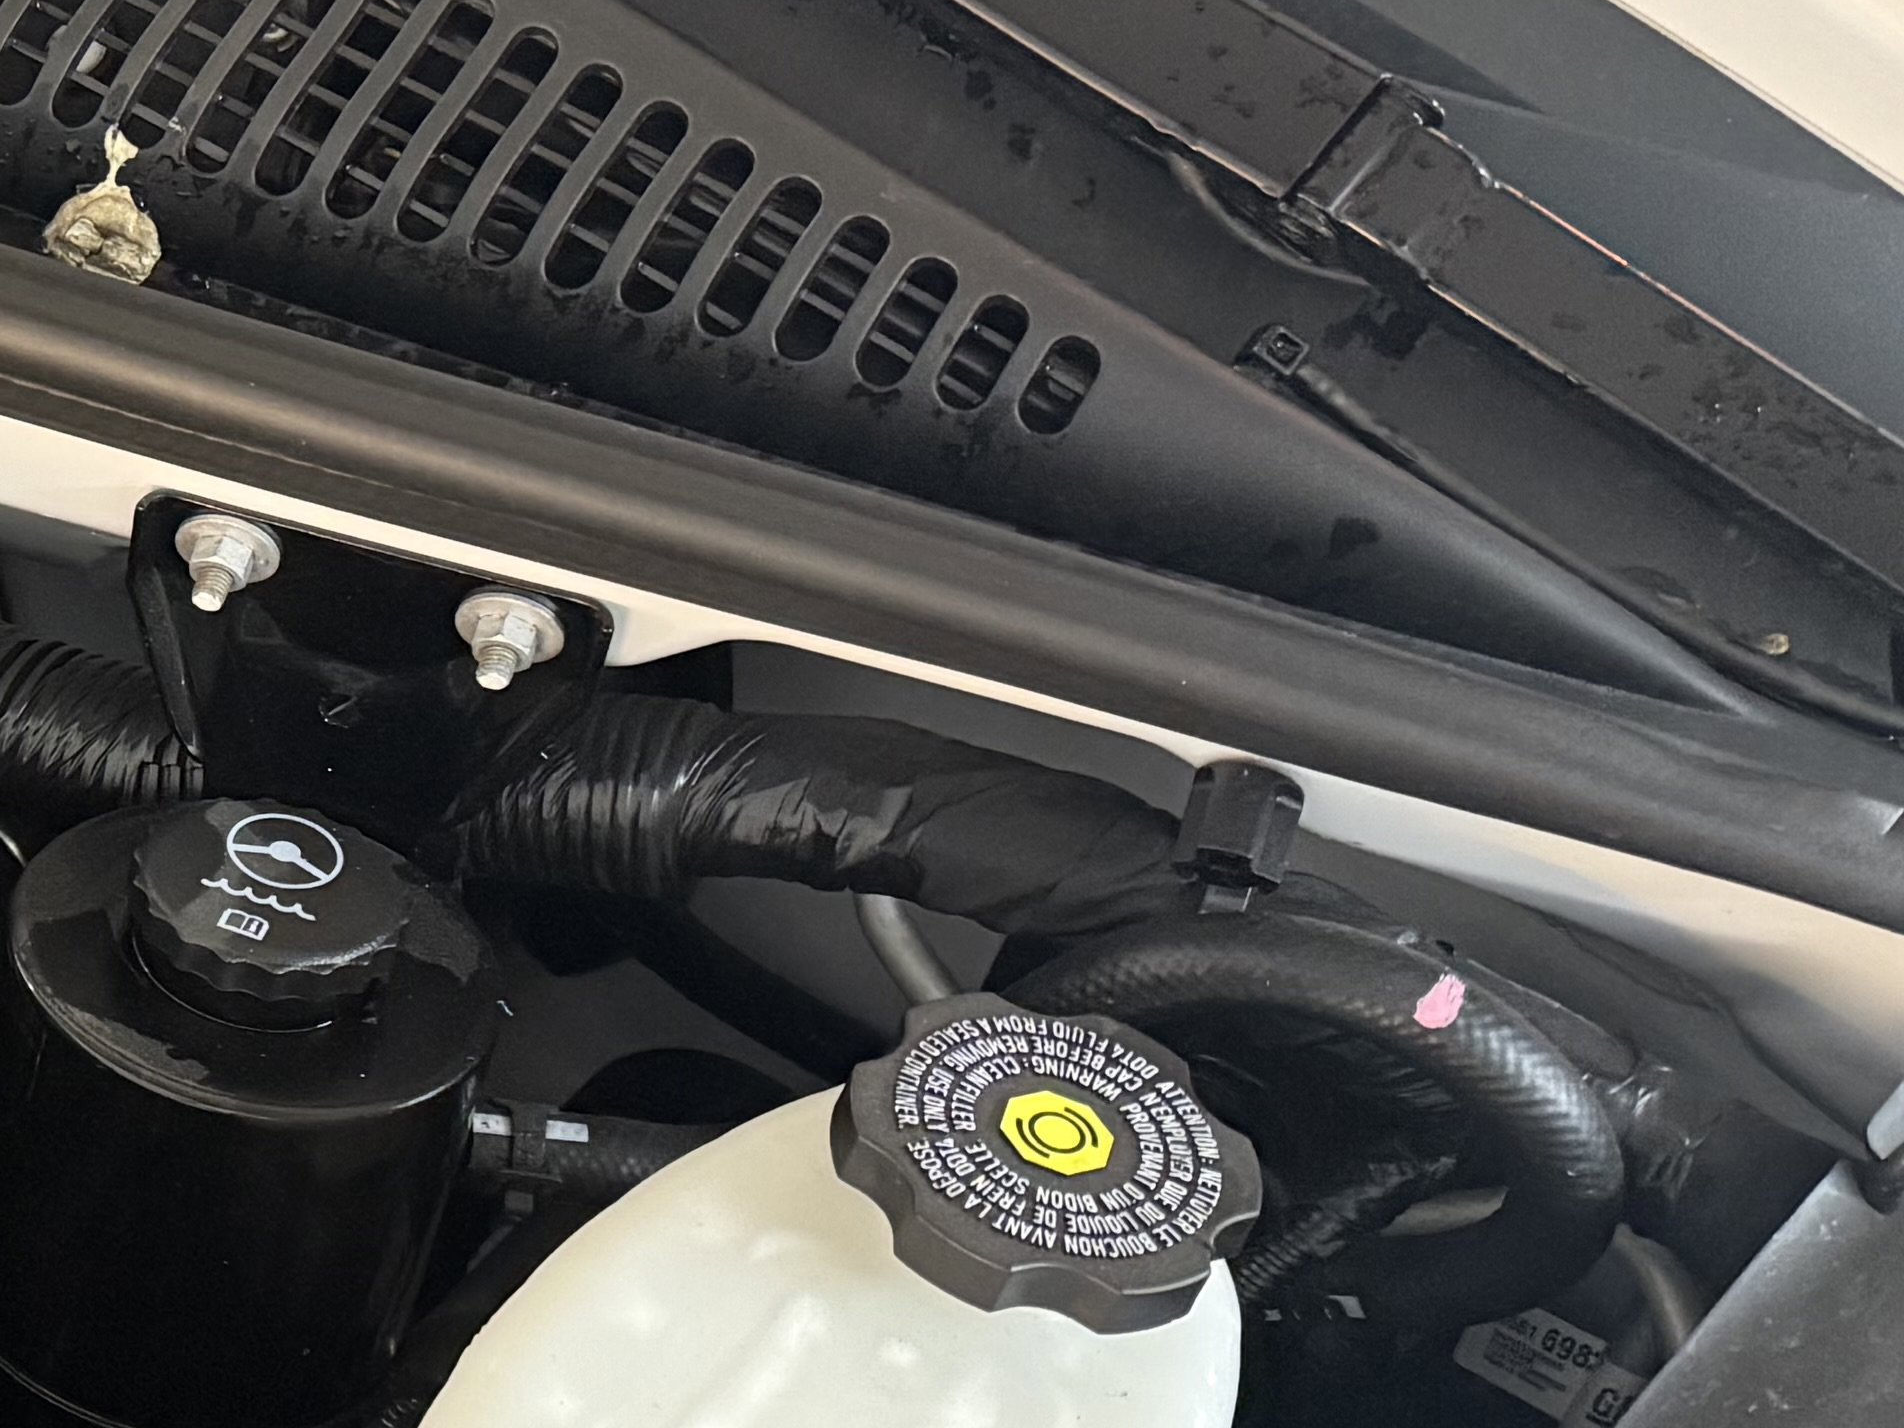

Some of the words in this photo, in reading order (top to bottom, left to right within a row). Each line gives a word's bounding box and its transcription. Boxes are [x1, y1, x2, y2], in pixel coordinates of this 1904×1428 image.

[919, 1020, 980, 1057] SEALED
[976, 1017, 992, 1034] A
[992, 1015, 1048, 1036] FROM
[1053, 1021, 1109, 1053] FLUID
[1030, 1036, 1106, 1071] BEFORE
[924, 1068, 954, 1097] USE
[965, 1056, 1021, 1089] CLEAN
[1105, 1065, 1143, 1092] CAP
[923, 1095, 950, 1132] ONLY
[951, 1081, 981, 1131] FILLER
[1120, 1103, 1164, 1190] PROVENANT
[964, 1193, 992, 1219] LA
[970, 1174, 1026, 1216] FREIN
[1036, 1186, 1098, 1213] BIDON
[1154, 1180, 1187, 1211] QUE
[1173, 1168, 1222, 1235] NETTOYER
[1033, 1205, 1057, 1228] DE
[1065, 1211, 1140, 1235] LIQUIDE
[1135, 1202, 1165, 1227] DU
[992, 1213, 1057, 1249] AVANT
[1064, 1232, 1157, 1258] BOUCHON
[1152, 1224, 1182, 1248] LE
